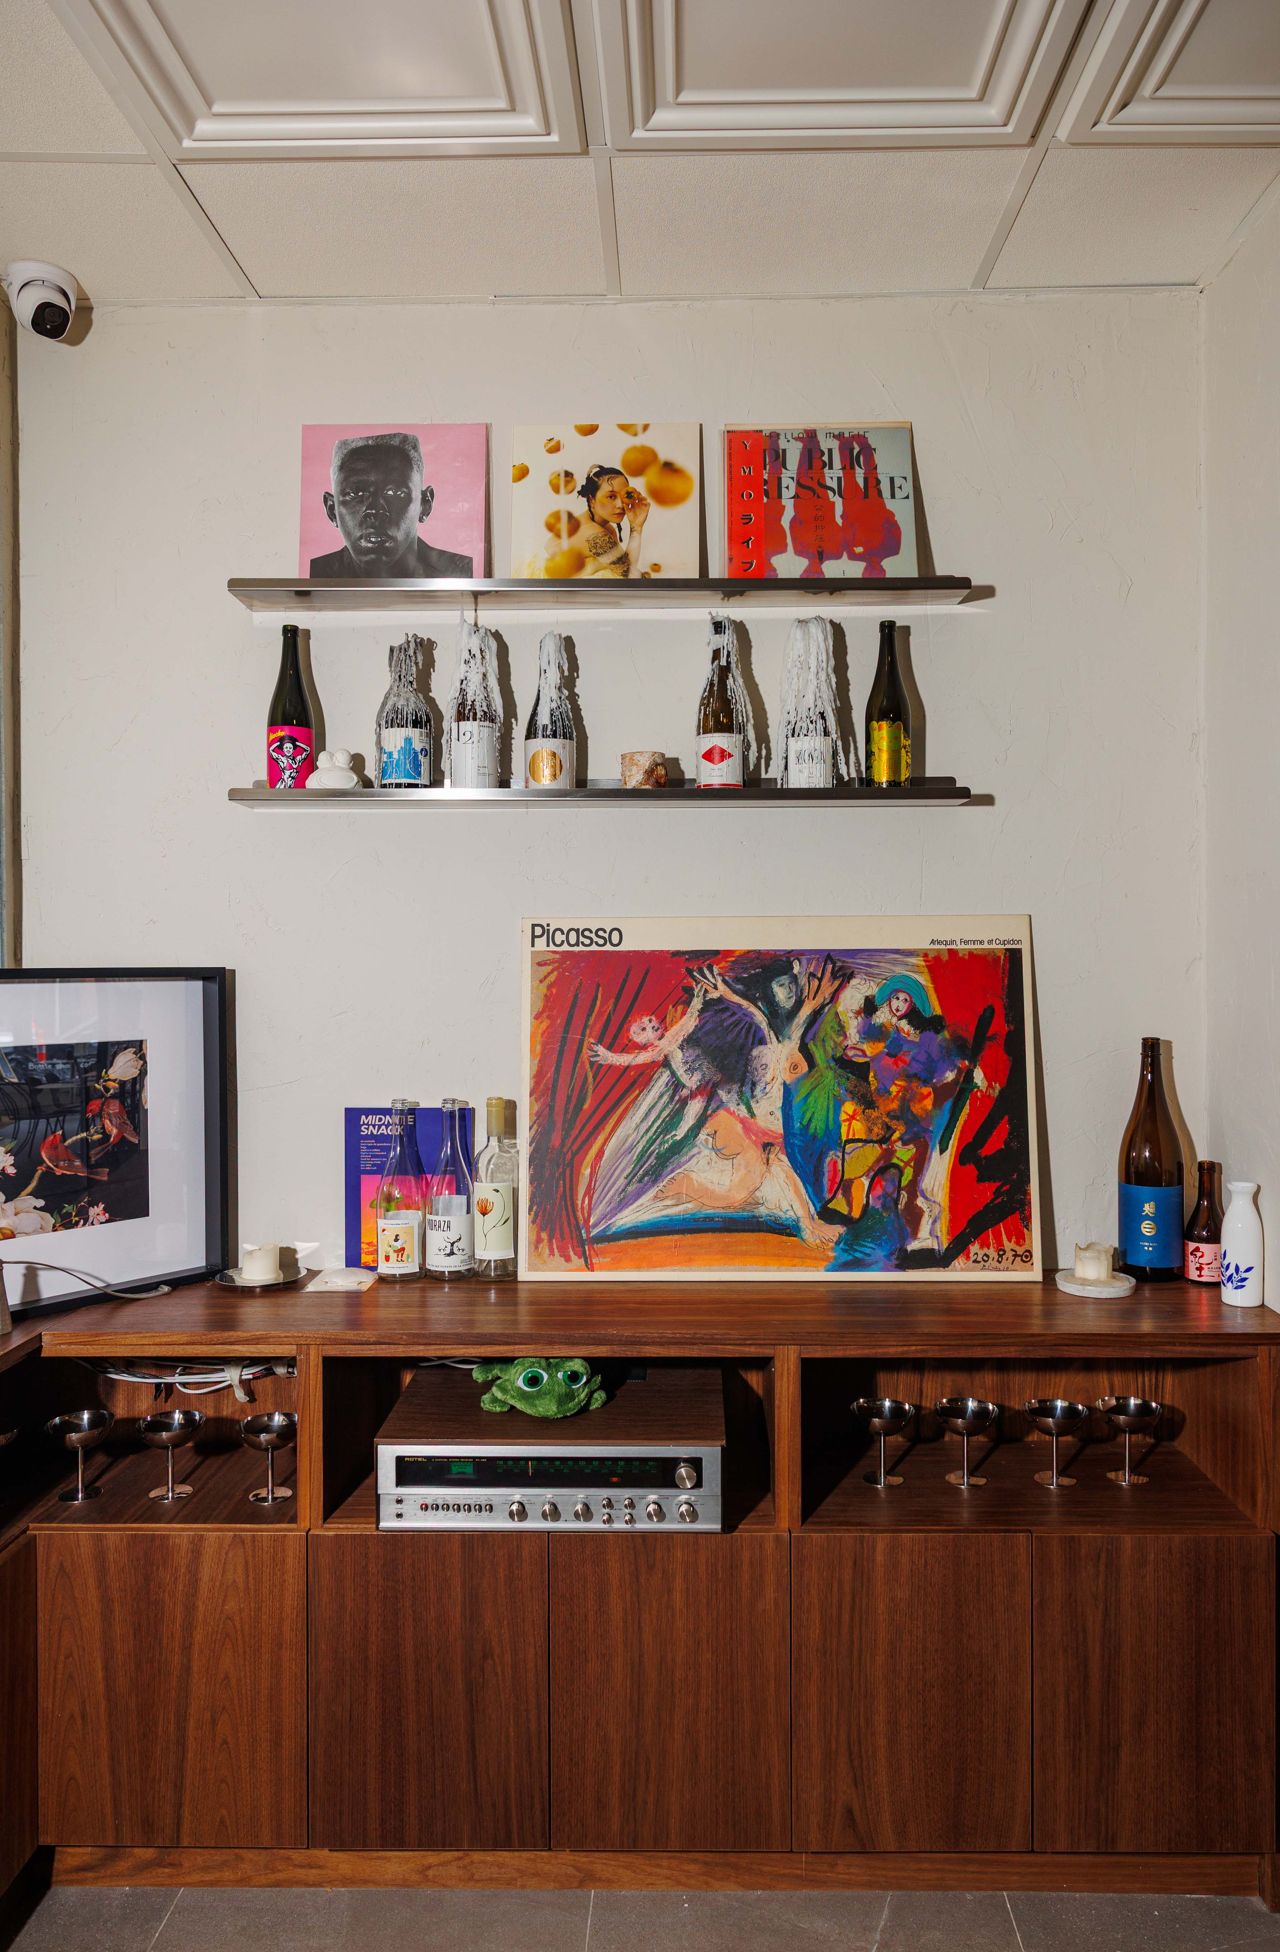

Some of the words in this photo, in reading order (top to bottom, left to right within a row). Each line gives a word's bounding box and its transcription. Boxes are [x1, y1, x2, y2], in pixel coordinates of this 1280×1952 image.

[763, 447, 878, 472] PUBLIC
[530, 923, 623, 948] Picasso
[929, 938, 958, 947] Arlequin,
[960, 938, 984, 946] Femme
[987, 938, 994, 946] et
[994, 938, 1022, 947] Cupidon
[360, 1125, 404, 1135] SNACK
